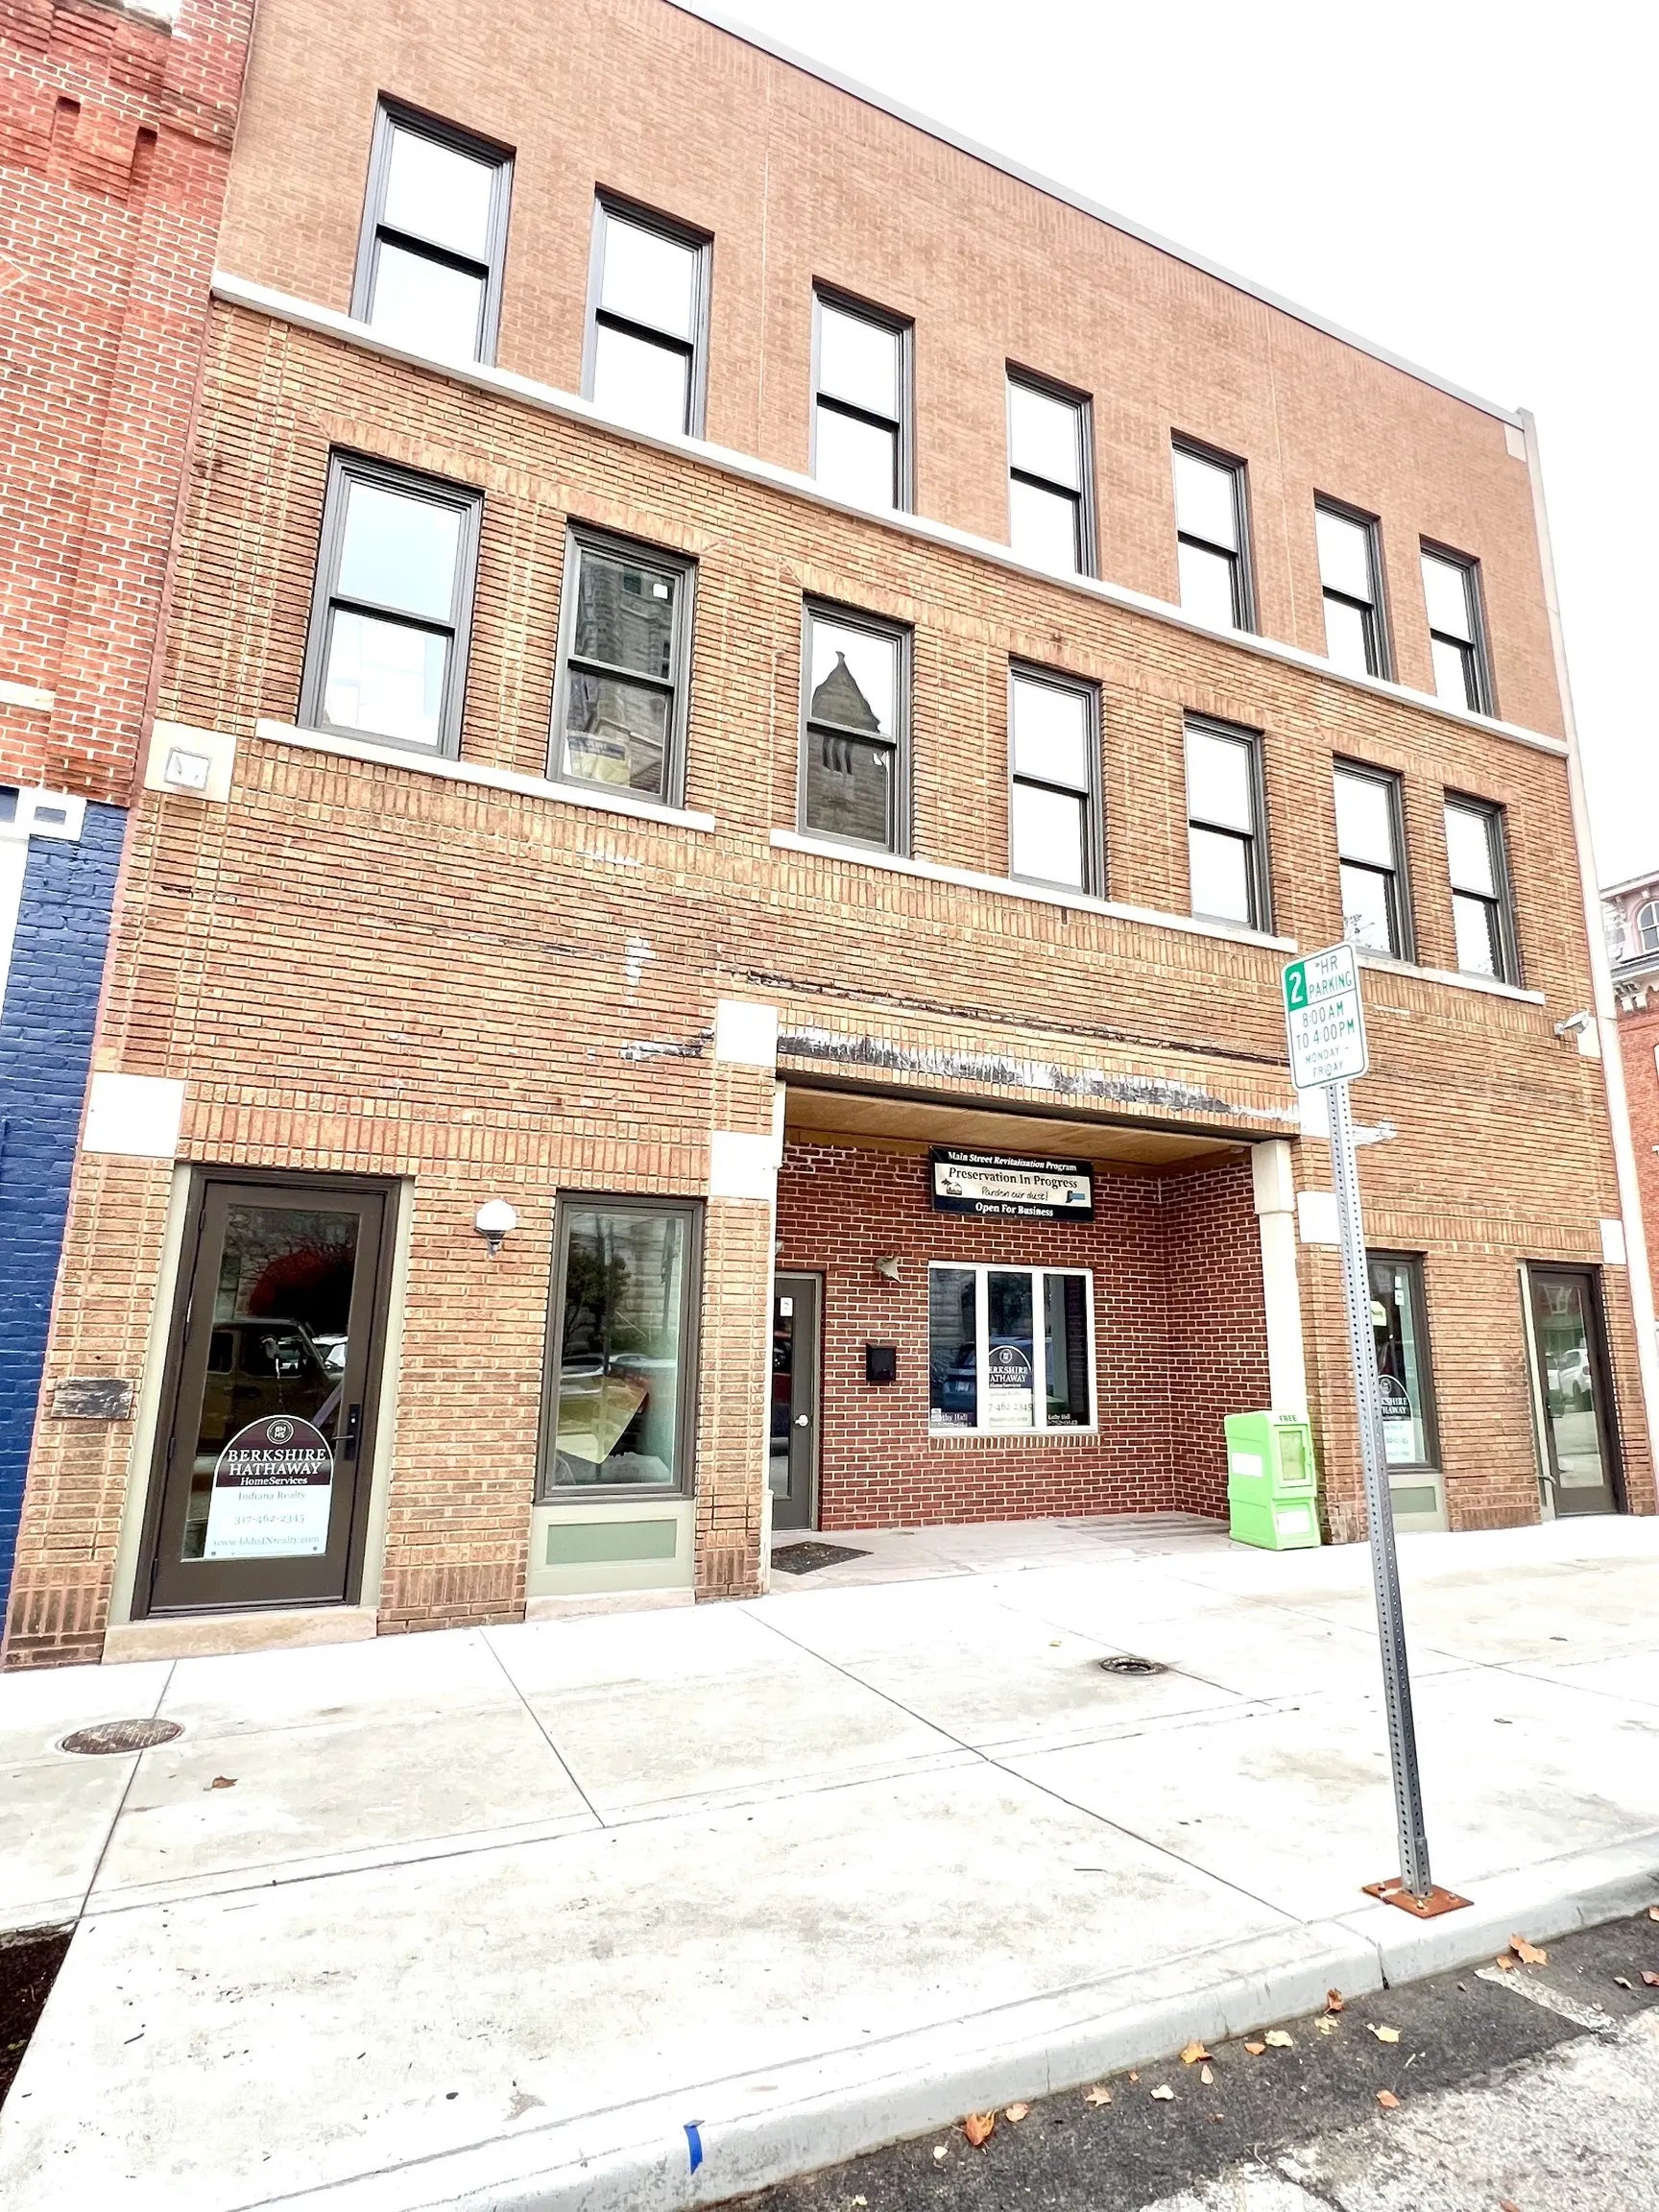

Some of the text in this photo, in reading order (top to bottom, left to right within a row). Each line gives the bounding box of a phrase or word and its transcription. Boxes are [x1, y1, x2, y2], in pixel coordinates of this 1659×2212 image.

[1288, 955, 1338, 1005] 2 HR
[1309, 972, 1353, 999] PARKING
[1296, 1033, 1310, 1051] TO
[1305, 1046, 1340, 1065] MONDAY
[1312, 1061, 1343, 1077] FRIDAY
[948, 1151, 1077, 1171] Main Street Revitalization Program
[949, 1166, 1078, 1190] Preservation In Progress
[981, 1186, 1048, 1201] Pardon our dust!
[974, 1202, 1054, 1217] Open For Business
[989, 1365, 1028, 1375] ERKSHIRE
[990, 1374, 1026, 1382] ATHAWAY
[228, 1449, 326, 1462] BERKSHIRE
[228, 1462, 322, 1476] HATHAWAY
[240, 1477, 308, 1485] HomeServices
[238, 1489, 306, 1501] Indiana Realty
[233, 1514, 305, 1525] 317-462-2345
